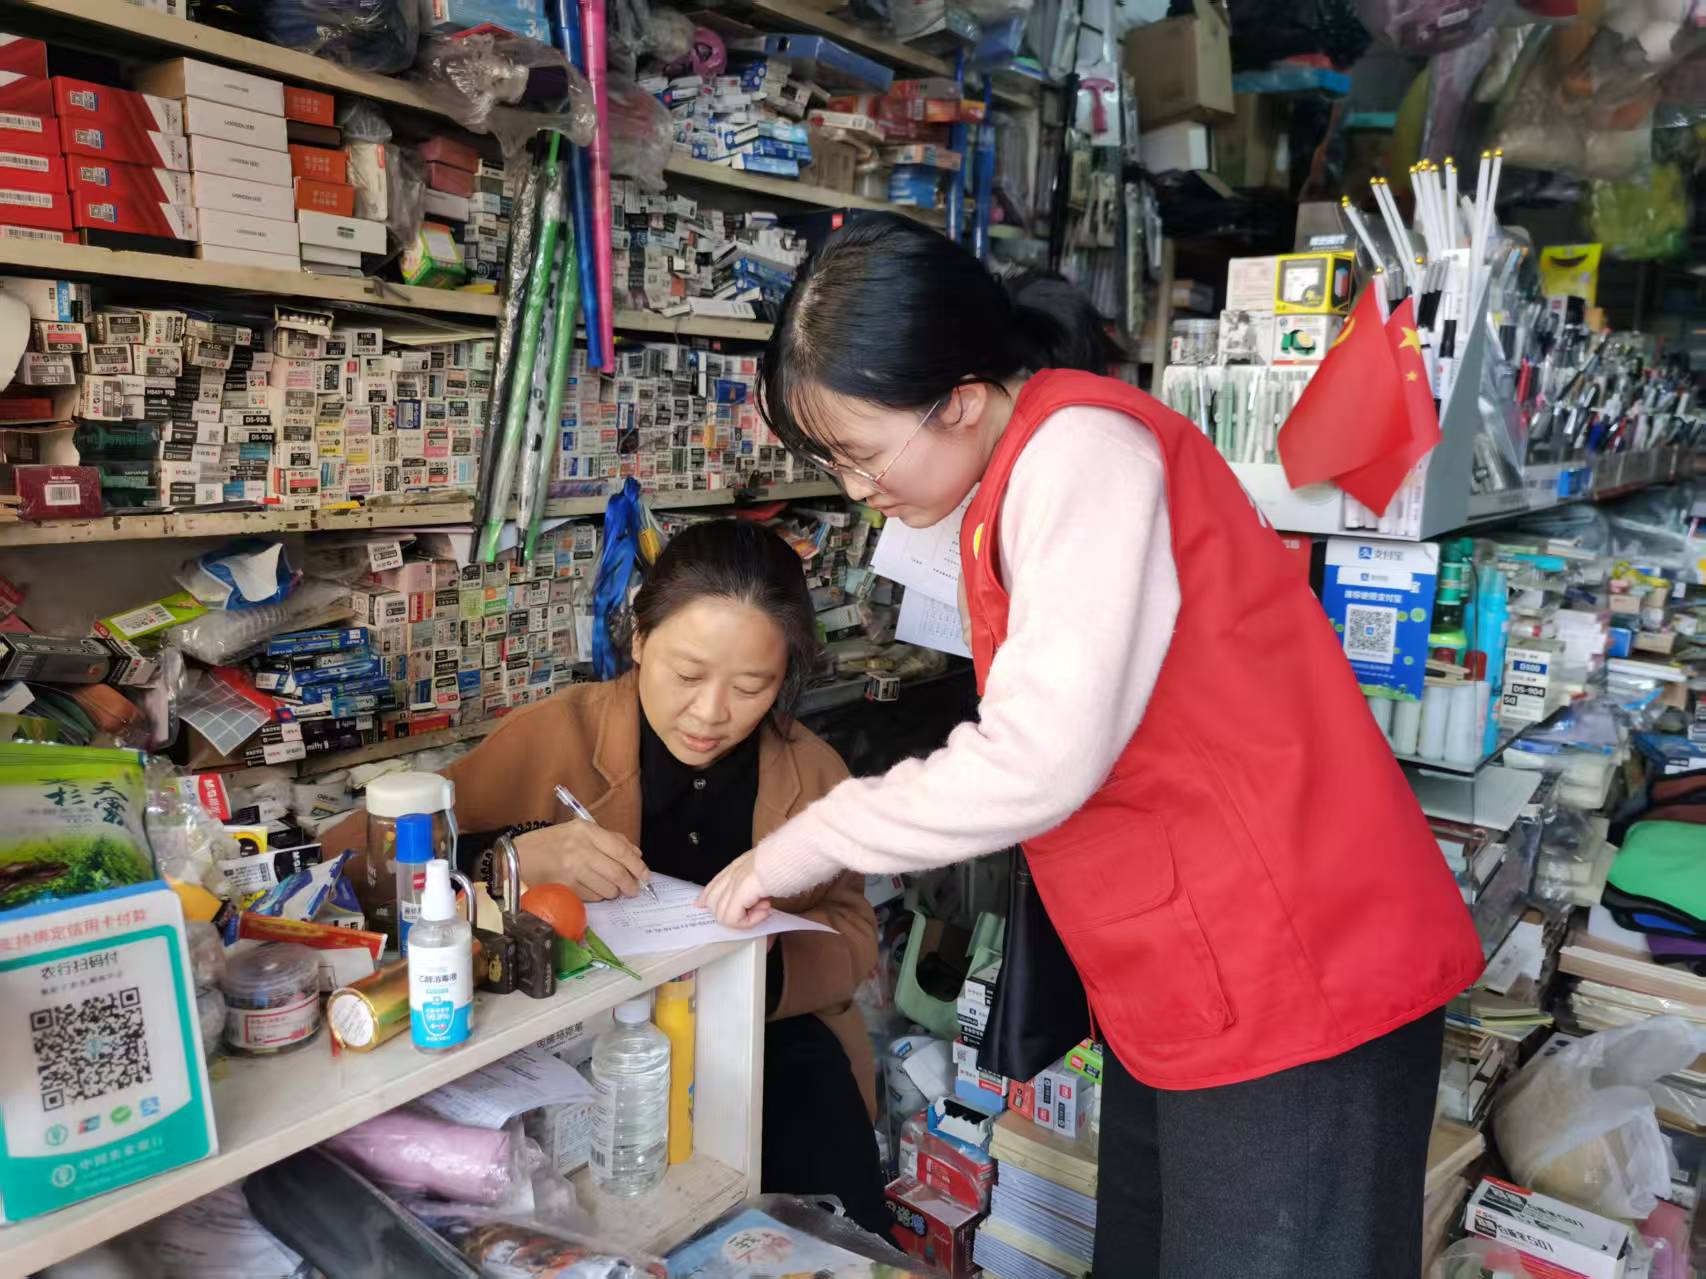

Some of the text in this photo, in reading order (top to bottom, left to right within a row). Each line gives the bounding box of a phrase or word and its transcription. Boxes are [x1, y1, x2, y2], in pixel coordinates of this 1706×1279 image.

[41, 952, 118, 978] 农行扫码付
